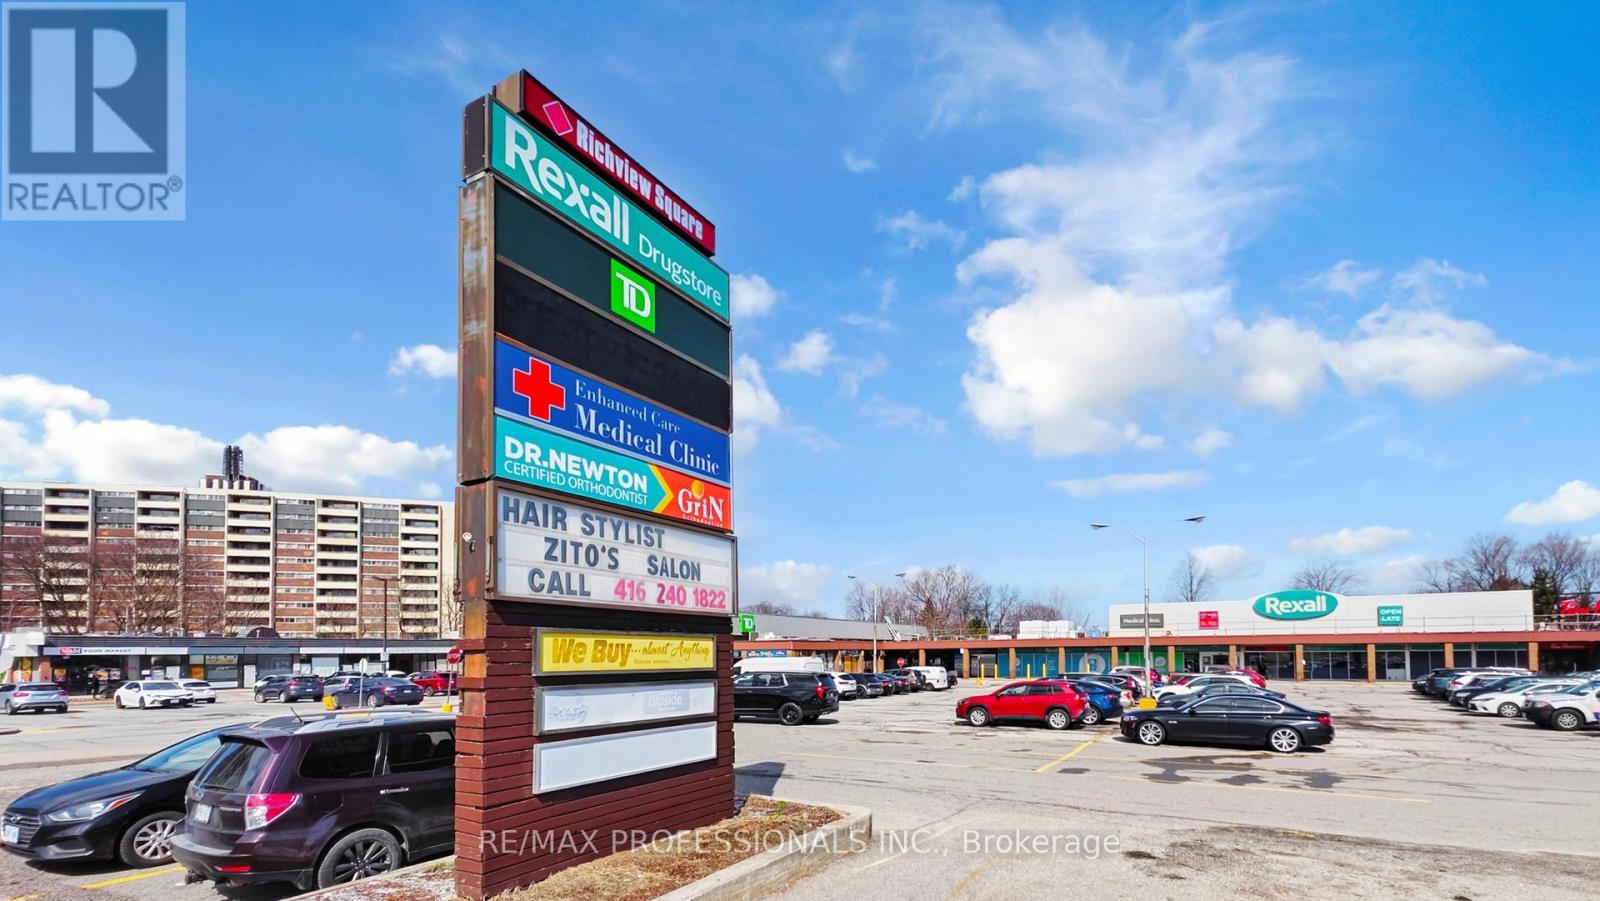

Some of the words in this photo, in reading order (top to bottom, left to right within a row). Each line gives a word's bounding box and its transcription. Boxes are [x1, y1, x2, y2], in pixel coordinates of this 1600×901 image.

[576, 120, 652, 201] Richview
[654, 185, 704, 241] Square
[504, 115, 630, 246] Rexall
[638, 234, 722, 306] Drugstore
[616, 272, 651, 319] TD
[575, 379, 648, 422] Enhanced
[651, 413, 681, 433] Care
[575, 403, 662, 457] Medical
[669, 440, 720, 475] Clinic
[504, 460, 566, 486] CERTIFIED
[568, 472, 649, 506] ORTHODONTIST
[677, 488, 724, 522] GriN
[503, 496, 567, 531] HAIR
[581, 513, 665, 549] STYLIST
[543, 537, 619, 570] ZITO'S
[647, 555, 701, 581] SALON
[527, 568, 591, 597] CALL
[614, 579, 646, 601] 416
[656, 583, 687, 605] 240
[693, 587, 726, 609] 1822
[1265, 595, 1326, 615] Rexall
[552, 638, 588, 664] We
[591, 639, 632, 667] Buy
[670, 640, 710, 661] Anything
